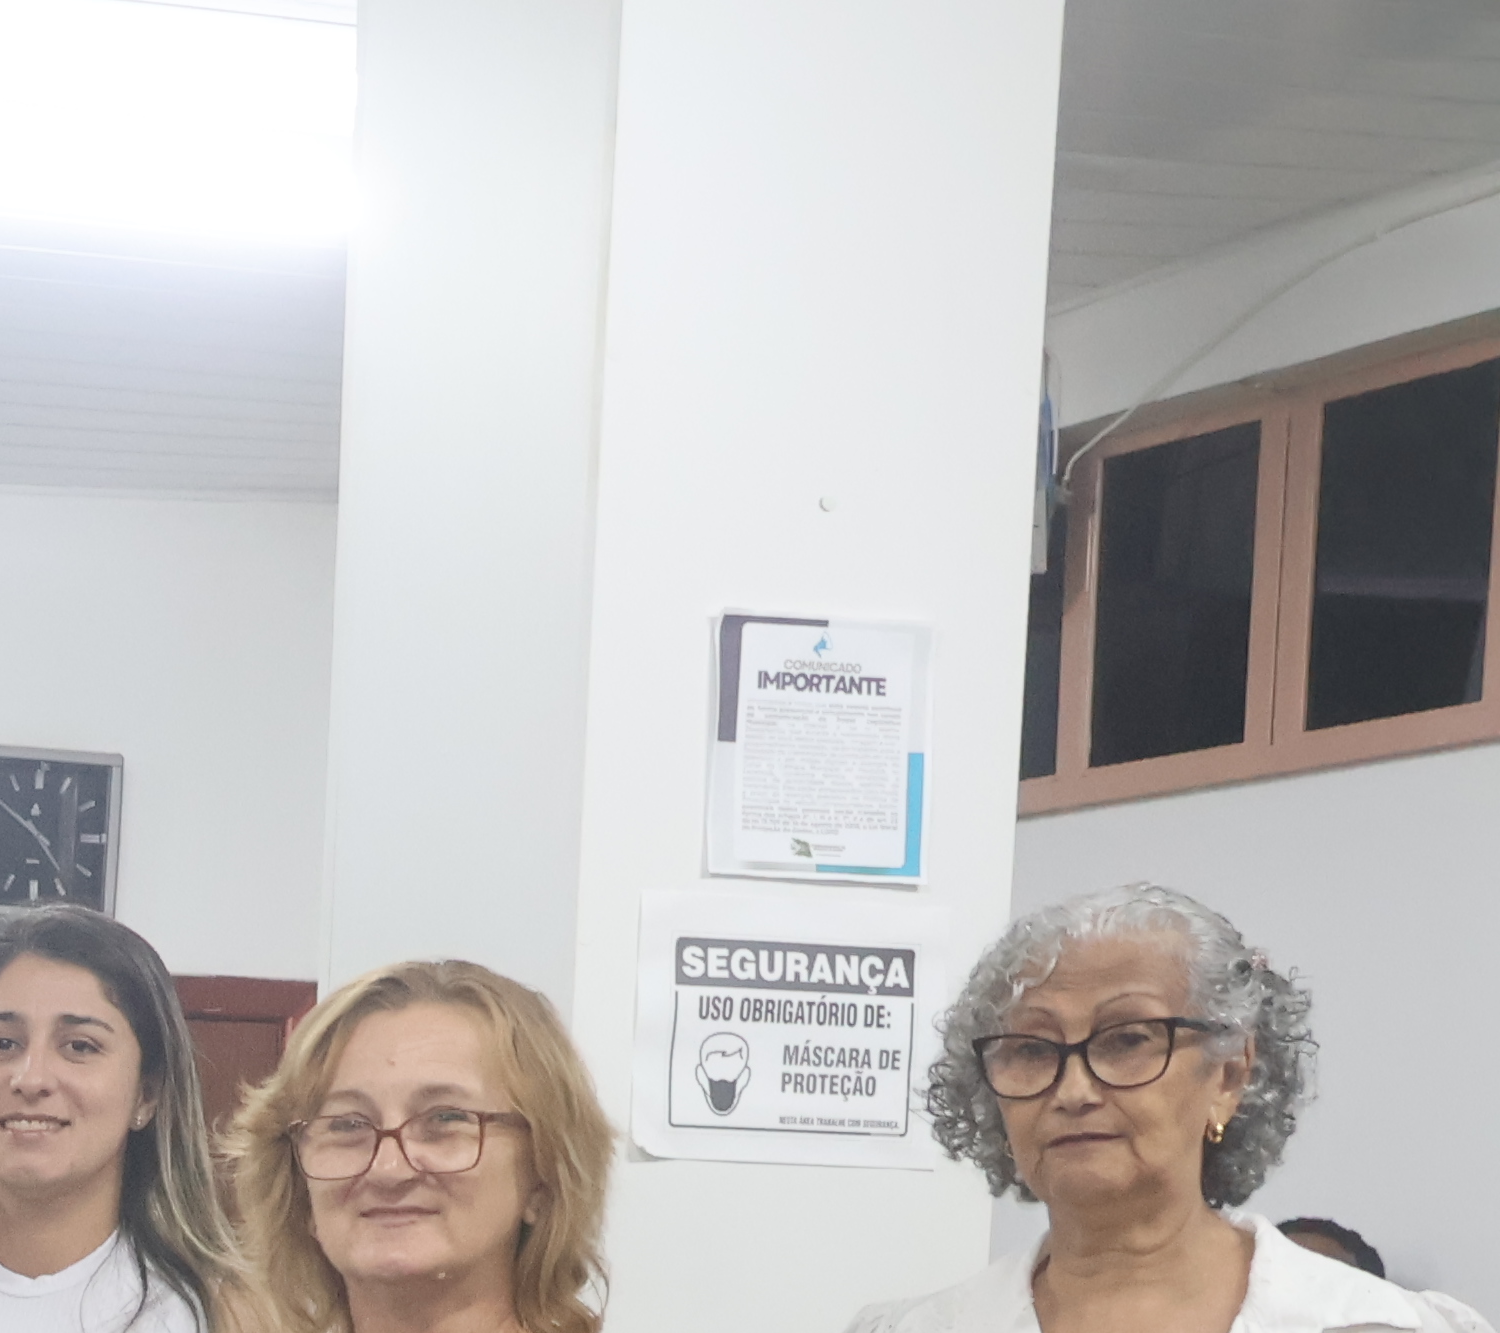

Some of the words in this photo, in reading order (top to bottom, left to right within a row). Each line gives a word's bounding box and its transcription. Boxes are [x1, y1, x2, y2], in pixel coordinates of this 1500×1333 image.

[784, 659, 862, 674] COMUNICADO
[757, 670, 887, 697] IMPORTANTE
[681, 945, 910, 995] SEGURANÇA
[699, 995, 733, 1021] USO
[739, 995, 858, 1028] OBRIGATÓRIO
[863, 1005, 892, 1029] DE:
[783, 1040, 872, 1070] MÁSCARA
[878, 1048, 902, 1071] DE
[781, 1071, 876, 1102] PROTEÇÃO
